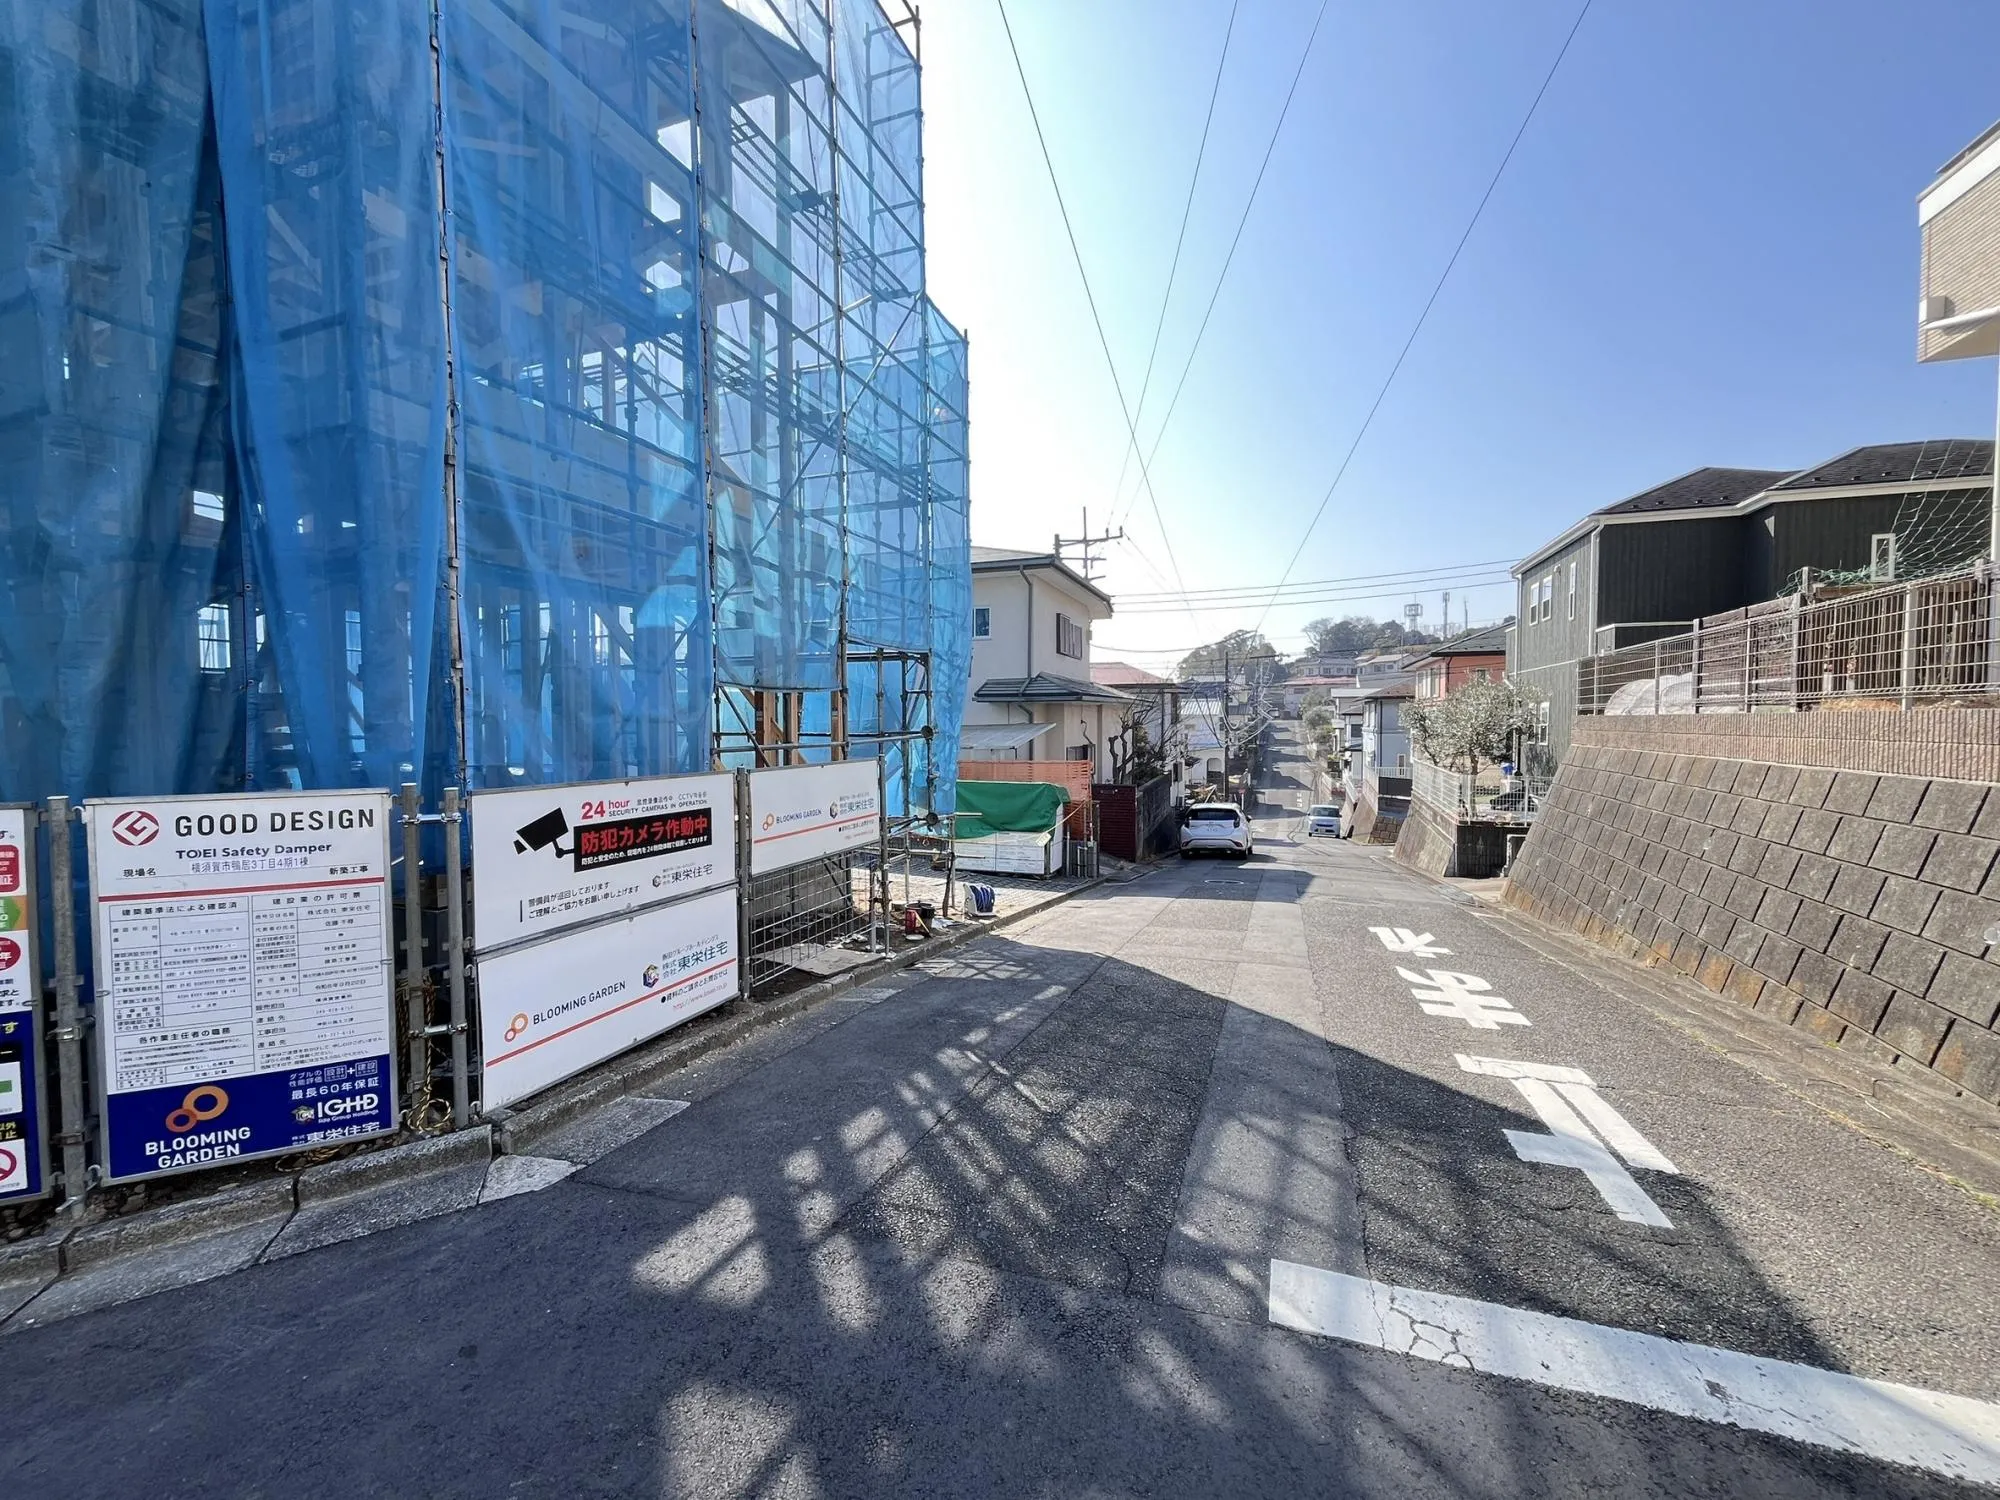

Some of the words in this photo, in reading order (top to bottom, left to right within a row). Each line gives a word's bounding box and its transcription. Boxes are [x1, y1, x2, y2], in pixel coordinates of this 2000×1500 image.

[581, 800, 606, 820] 24
[608, 800, 631, 809] hour
[608, 808, 639, 817] SECURITY
[641, 804, 668, 813] CAMERAS
[678, 799, 708, 808] OPERATION
[776, 812, 802, 824] BLOOMING
[803, 808, 822, 820] GARDEN
[175, 813, 258, 838] GOOD
[270, 808, 374, 834] DESIGN
[581, 815, 708, 856] 防犯カメラ作動中
[222, 844, 270, 859] Safety
[275, 843, 333, 856] Damper
[123, 866, 157, 878] 現場名
[328, 865, 369, 876] 新築工事
[672, 864, 713, 883] 東栄住宅
[528, 881, 611, 908] 警備員が巡回しております
[528, 885, 640, 919] ご理解とご協力をお願い申し上げます
[677, 941, 728, 973] 東栄住宅
[532, 995, 587, 1025] BLOOMING
[588, 980, 626, 1003] GARDEN
[291, 1076, 380, 1101] 最長60年保証
[1367, 926, 1682, 1231] 止まれ
[317, 1093, 379, 1118] IGHD
[144, 1126, 251, 1156] BLOOMING
[306, 1121, 380, 1143] 東栄住宅
[158, 1142, 240, 1169] GARDEN
